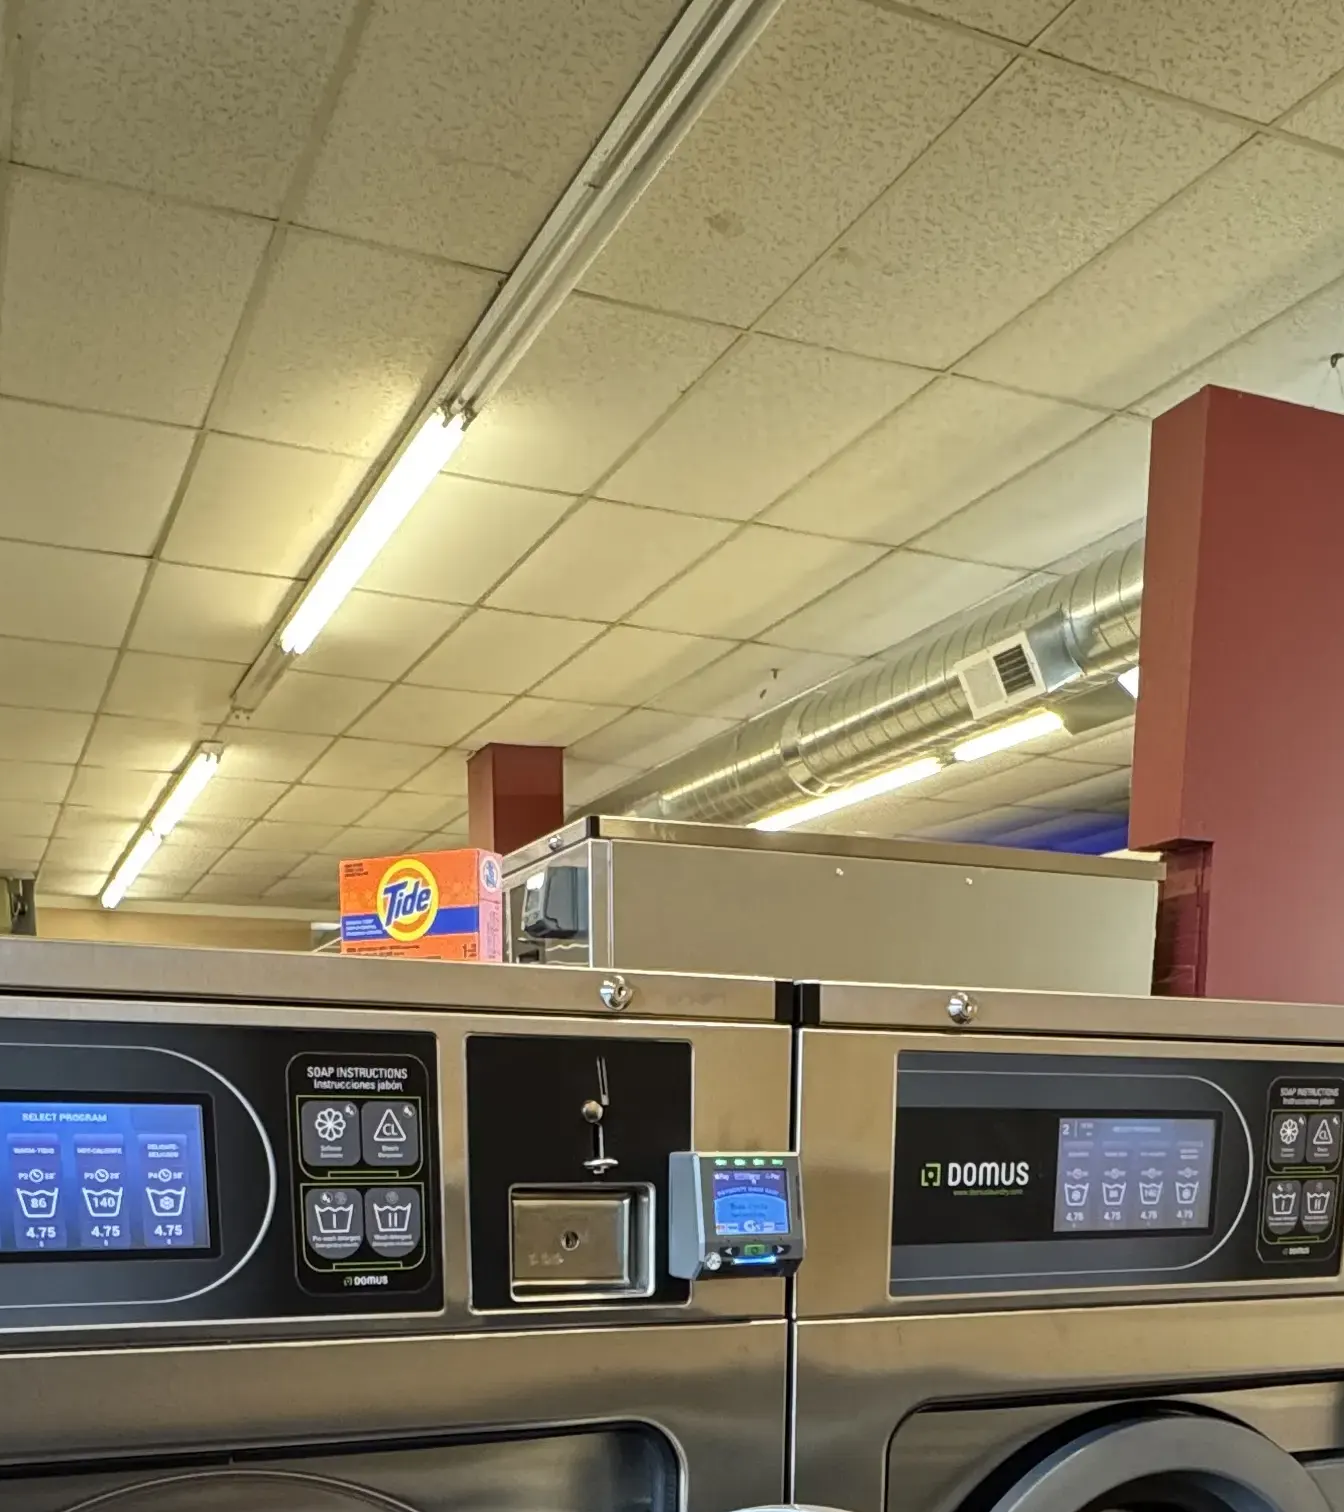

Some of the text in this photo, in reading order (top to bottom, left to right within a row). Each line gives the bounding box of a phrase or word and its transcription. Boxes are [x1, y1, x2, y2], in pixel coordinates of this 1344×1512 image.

[383, 880, 432, 928] Tide
[307, 1066, 408, 1079] SOAP INSTRUCTIONS
[313, 1079, 376, 1090] Instrucciones
[22, 1112, 108, 1122] SELECT PROGRAM
[382, 1123, 398, 1136] CL
[947, 1161, 1030, 1187] DOMUS
[30, 1198, 47, 1209] 86
[92, 1196, 115, 1208] 140
[25, 1226, 57, 1239] 4.75
[91, 1225, 121, 1237] 4.75
[153, 1224, 183, 1237] 4.75
[353, 1275, 389, 1286] DOMUS
